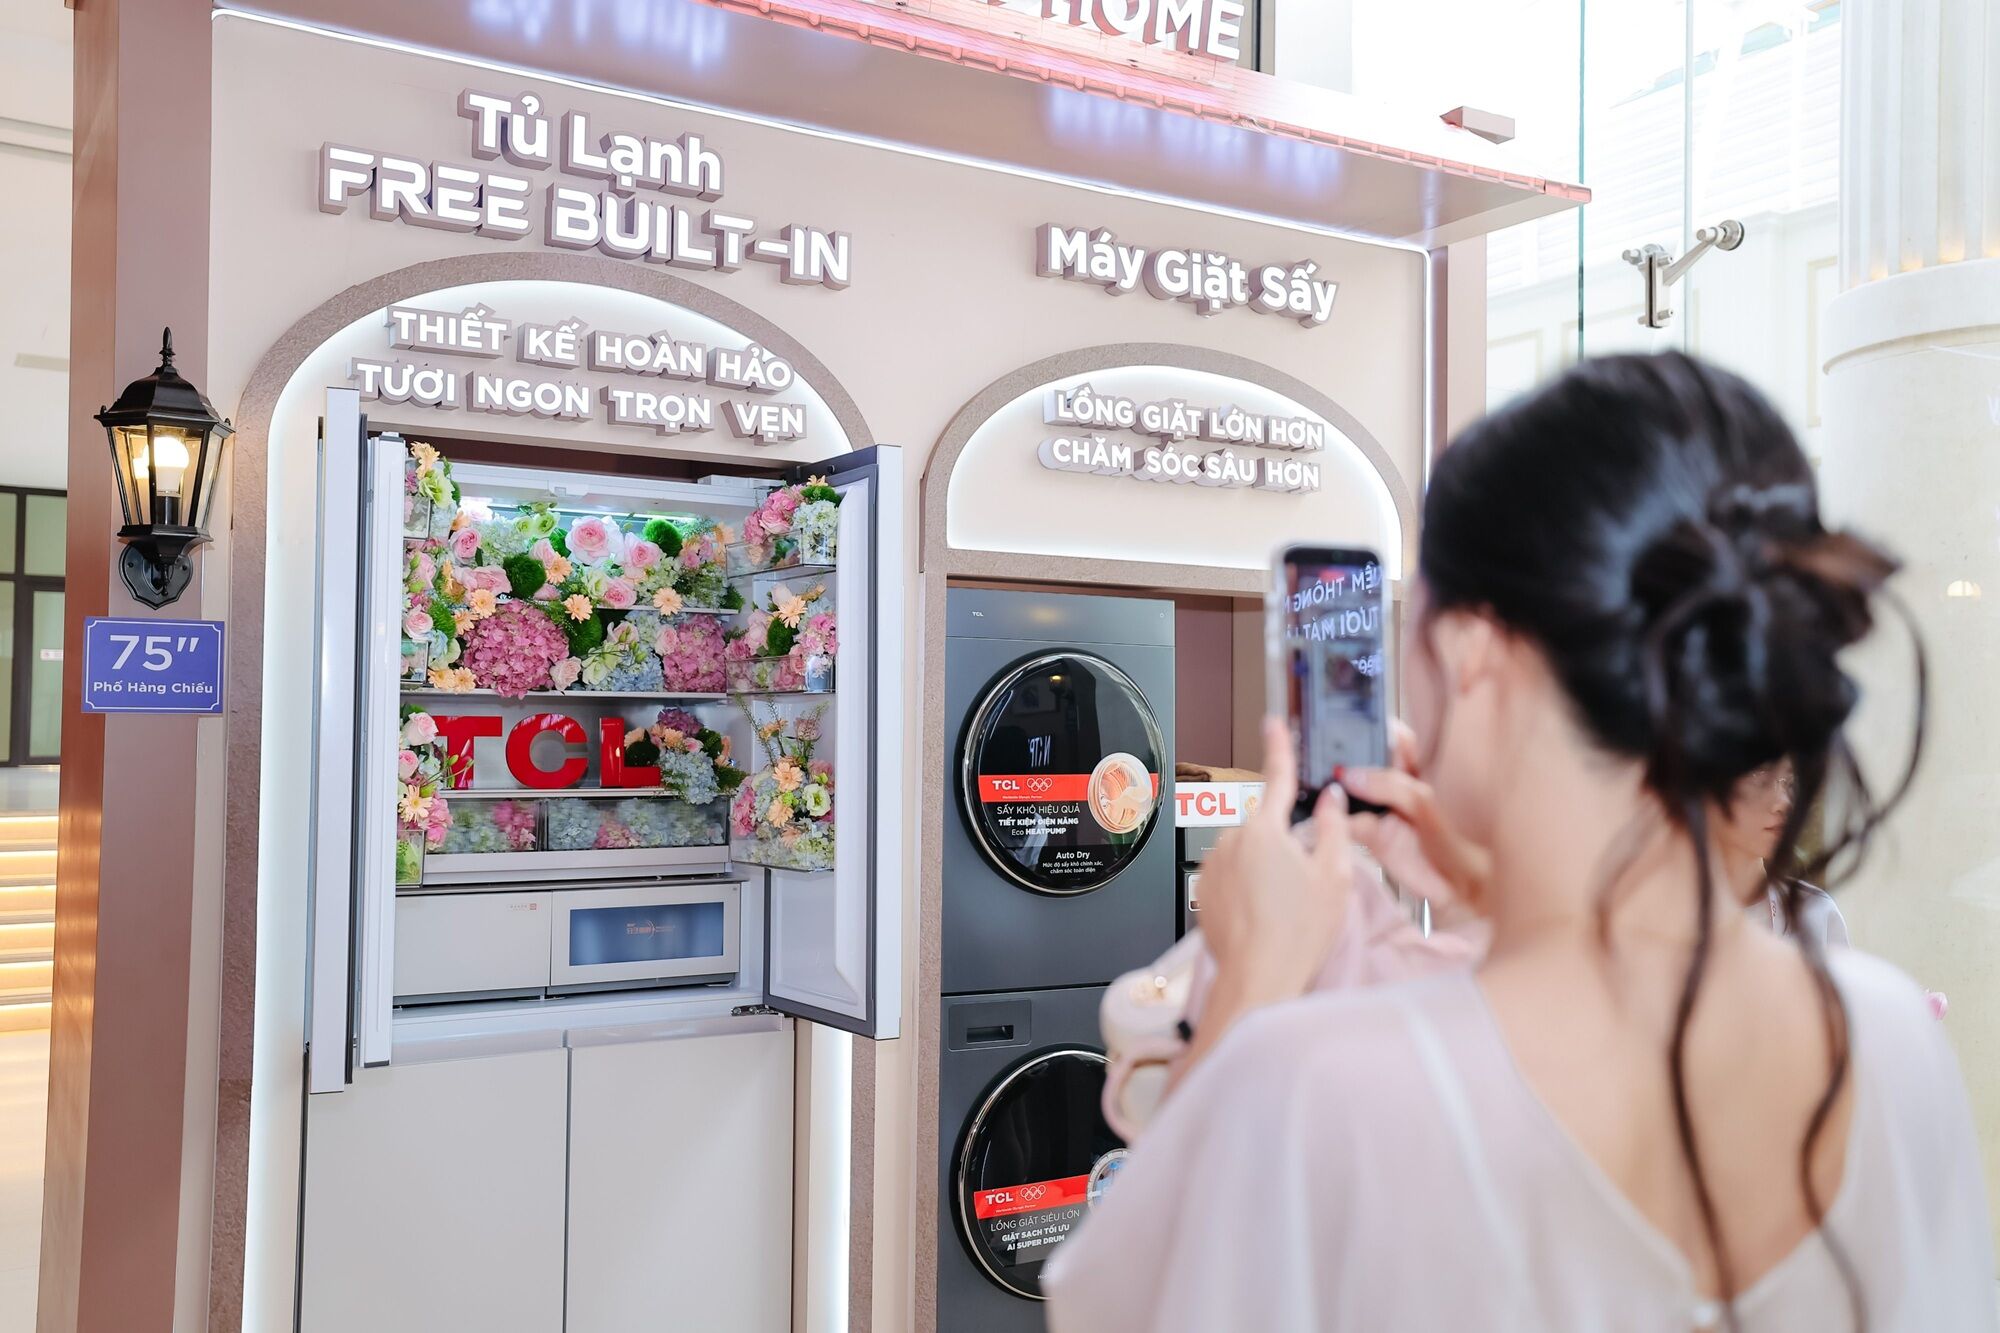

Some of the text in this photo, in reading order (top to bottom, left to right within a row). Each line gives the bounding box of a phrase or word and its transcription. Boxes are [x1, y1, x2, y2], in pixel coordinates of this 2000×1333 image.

[469, 94, 721, 192] Tủ Lạnh
[329, 149, 848, 282] FREE BUILT-IN
[1050, 227, 1337, 322] Máy Giặt Sấy
[393, 308, 792, 387] THIẾT KẾ HOÀN HẢO
[357, 363, 803, 441] TƯƠI NGON TRỌN VẸN
[1058, 387, 1324, 447] LỒNG GIẶT LỚN HƠN
[1053, 437, 1319, 487] CHĂM SÓC SÂU HƠN
[93, 680, 213, 695] Phố Hàng Chiếu
[434, 713, 661, 790] TCL
[992, 780, 1020, 790] TCL
[997, 803, 1080, 815] SẤY KHÔ HIỆU QUẢ
[1174, 792, 1236, 816] TCL
[999, 817, 1016, 826] TIẾT
[1017, 817, 1036, 827] KIỆM
[1056, 851, 1090, 860] Auto Dry
[985, 1192, 1014, 1205] TCL
[1018, 1215, 1039, 1227] GIẶT
[1040, 1212, 1060, 1223] SIÊU
[1061, 1209, 1080, 1220] LỚN
[1001, 1231, 1020, 1243] GIẶT
[1021, 1229, 1043, 1240] SẠCH
[1043, 1225, 1057, 1234] TỐI
[1006, 1235, 1065, 1251] AI SUPER DRUM
